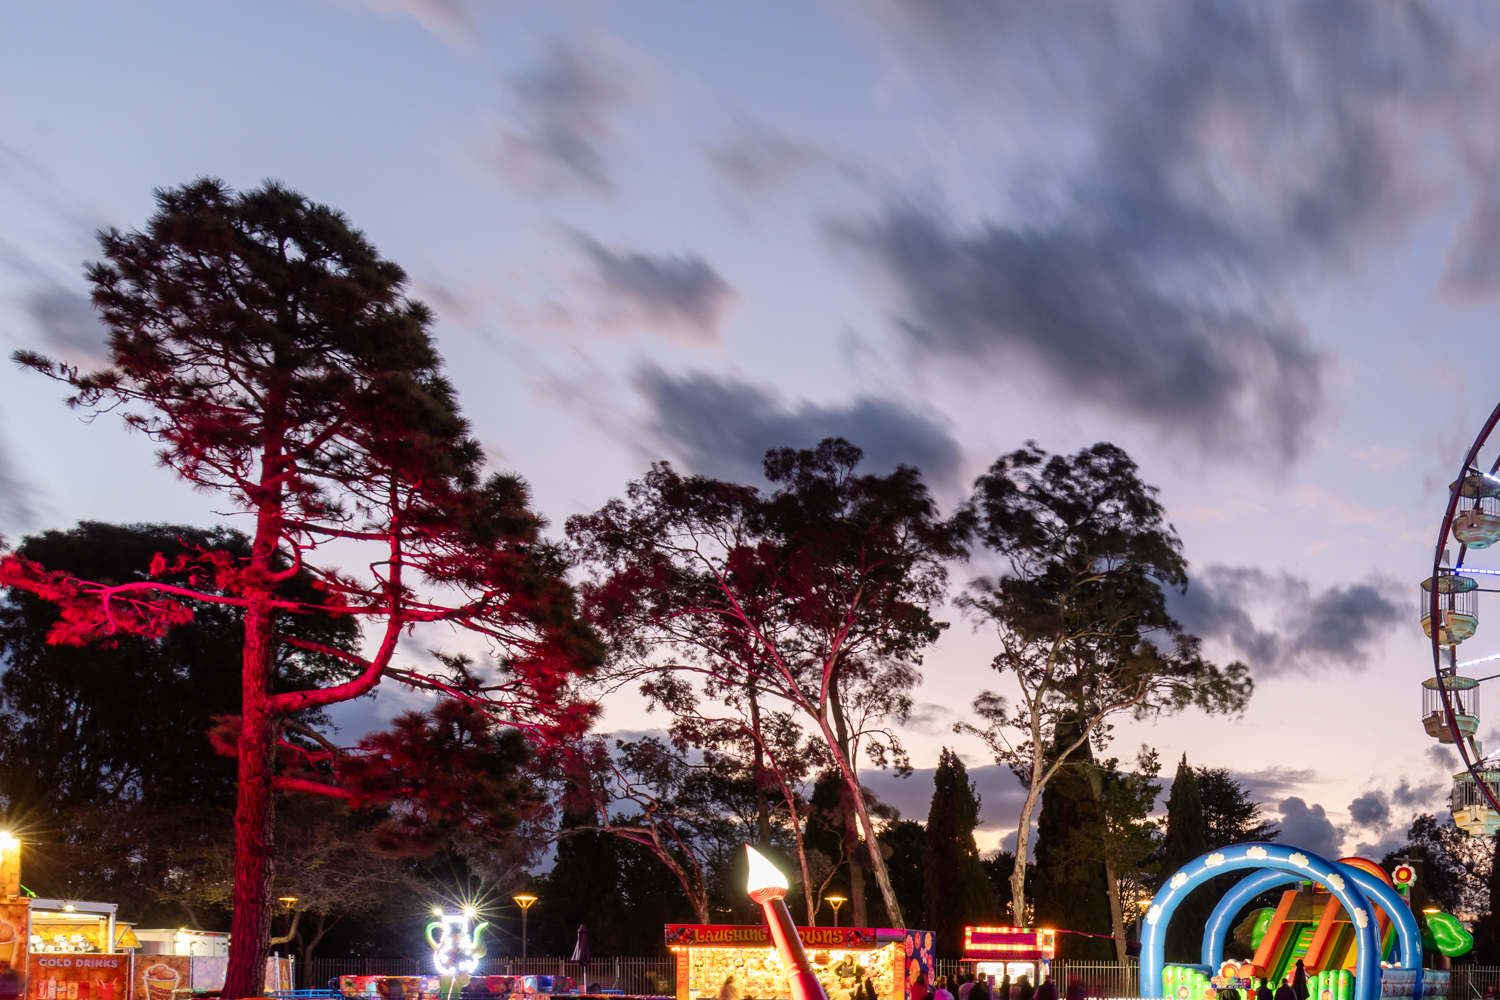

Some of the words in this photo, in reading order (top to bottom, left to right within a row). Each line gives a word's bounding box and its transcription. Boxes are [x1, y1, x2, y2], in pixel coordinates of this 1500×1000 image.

[693, 928, 767, 943] LAUGHING
[797, 929, 843, 946] OWNS
[39, 958, 72, 967] COLD
[75, 959, 118, 968] DRINKS
